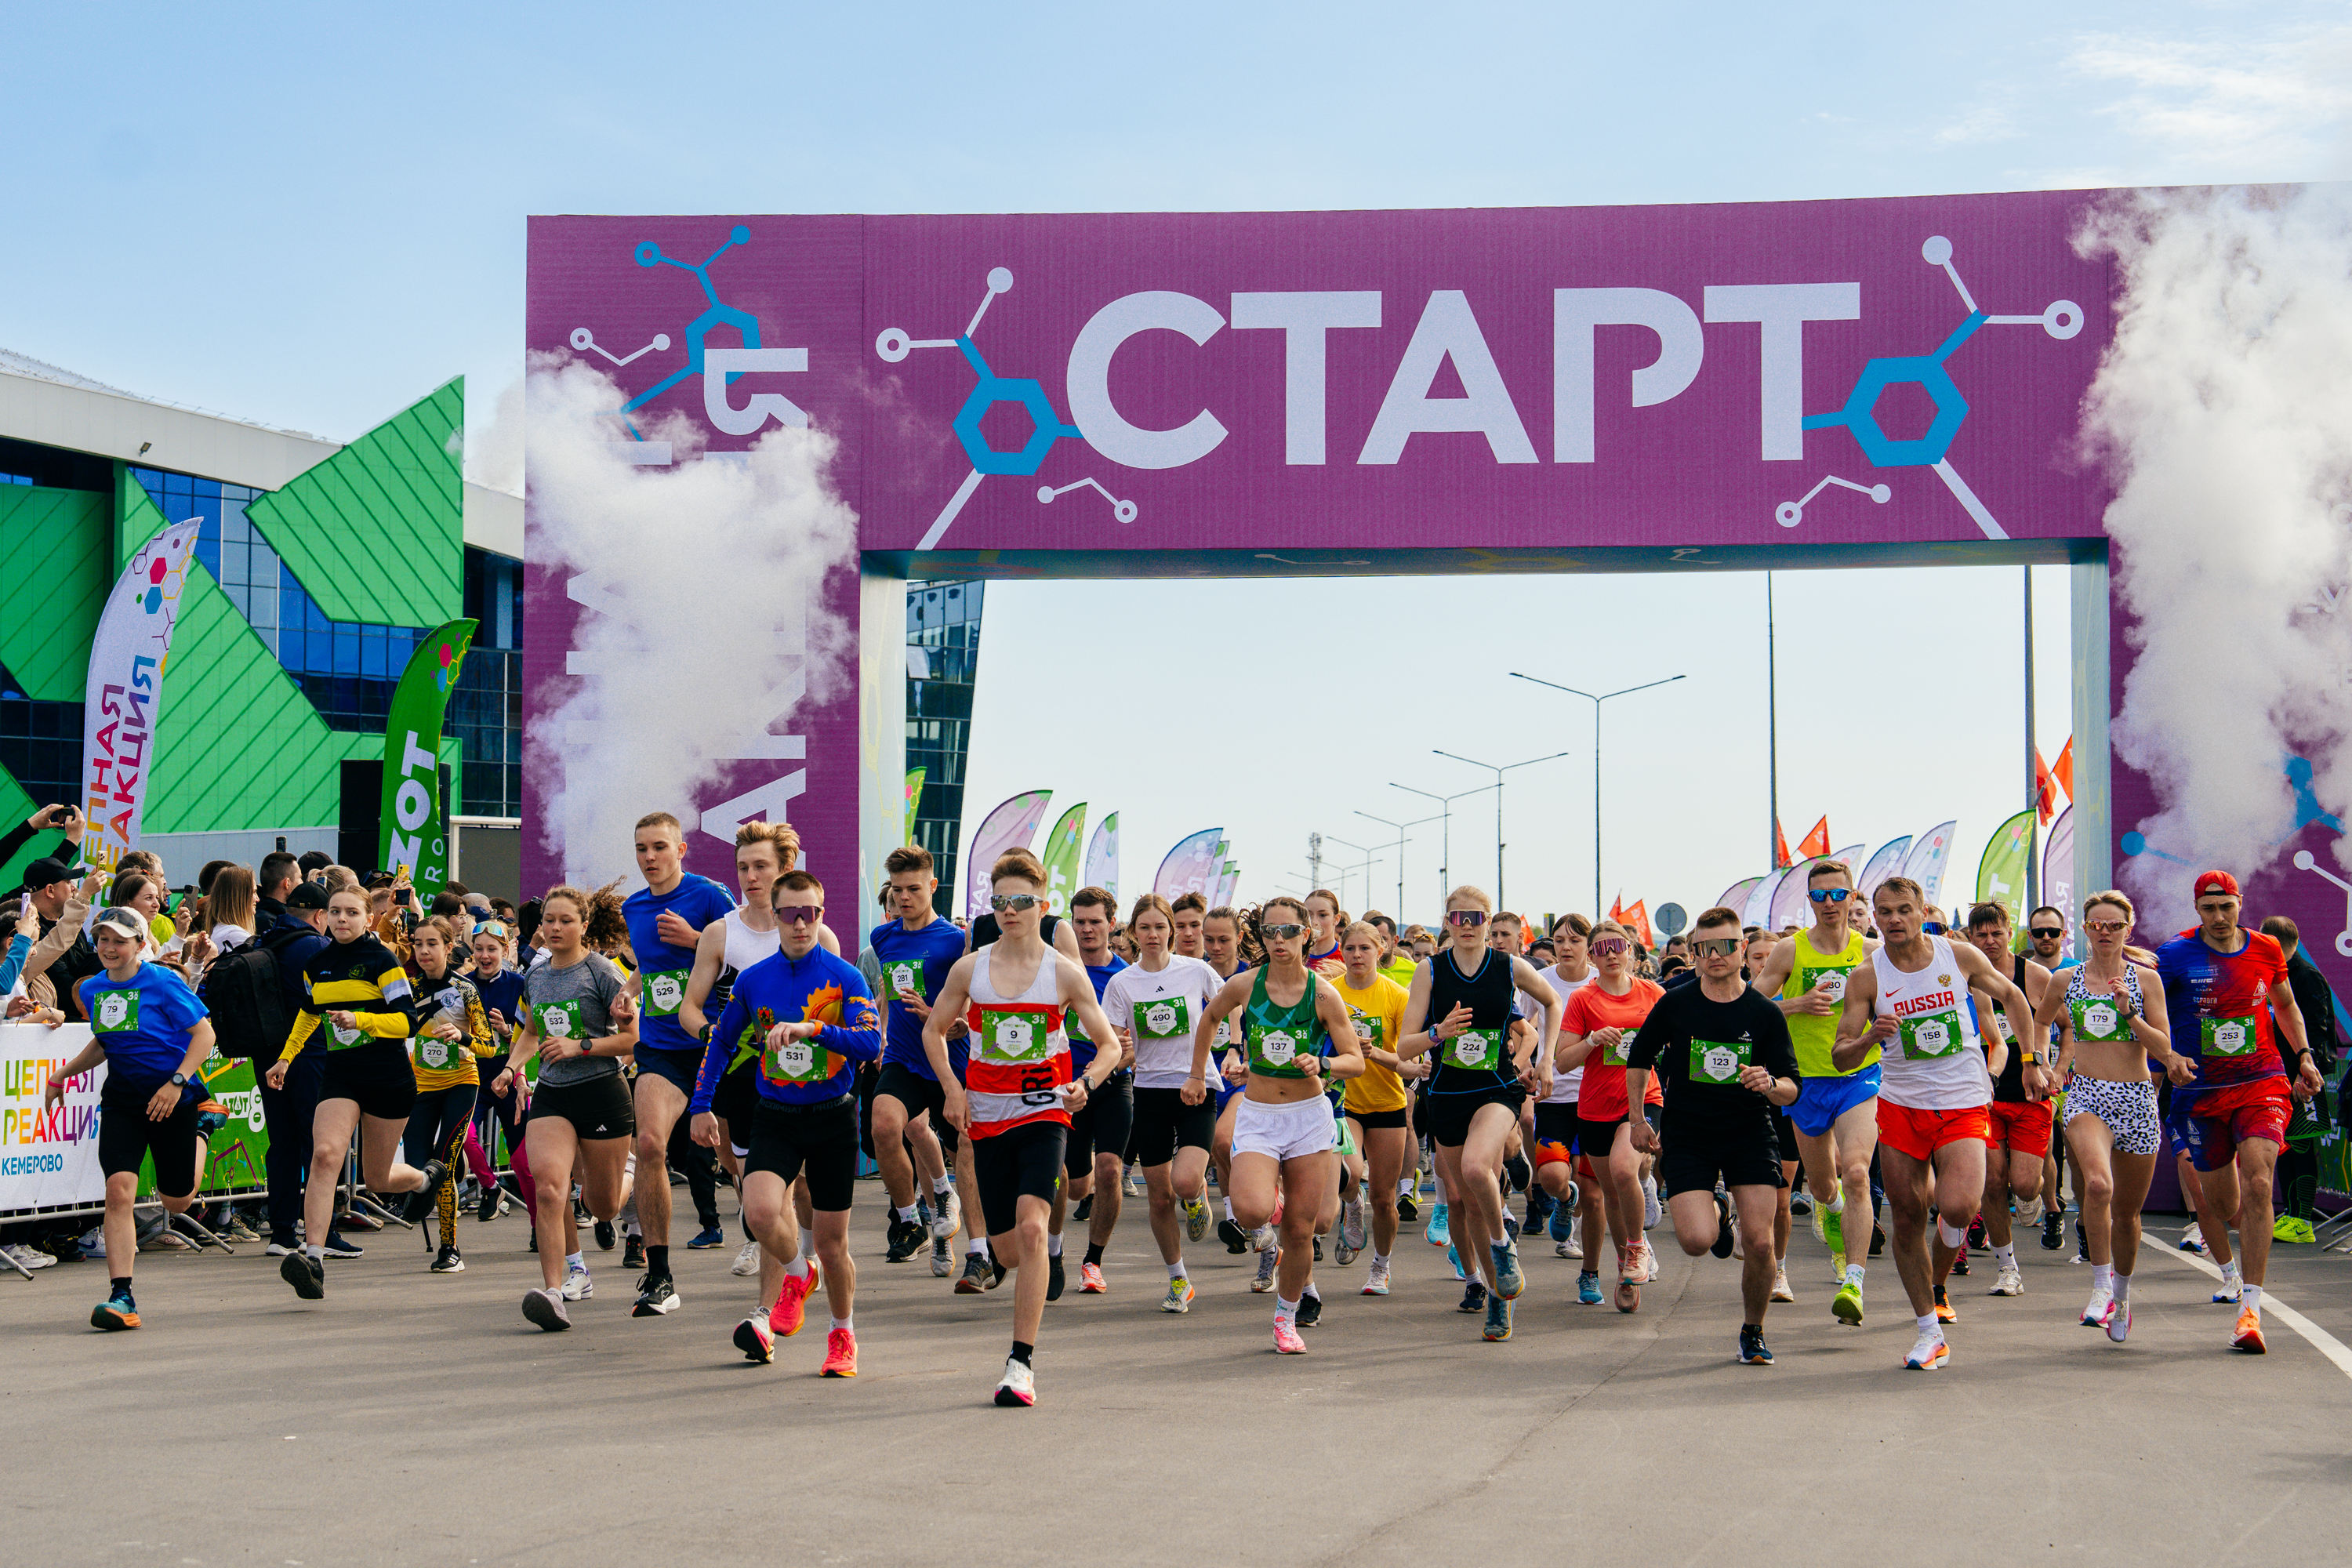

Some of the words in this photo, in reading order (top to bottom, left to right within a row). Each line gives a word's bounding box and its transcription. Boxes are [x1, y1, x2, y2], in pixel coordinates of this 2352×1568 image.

[1066, 281, 1861, 469] СТАРТ
[79, 683, 125, 906] ЕПНАЯ
[387, 730, 436, 882] ZOT
[419, 820, 444, 910] GRO
[656, 986, 674, 996] 529
[1894, 990, 1955, 1017] RUSSIA
[549, 1017, 564, 1025] 532
[1152, 1013, 1171, 1022] 490
[2092, 1014, 2108, 1023] 179
[1010, 1030, 1018, 1040] 9
[1923, 1030, 1941, 1040] 158
[2222, 1032, 2239, 1040] 253
[1462, 1043, 1480, 1052] 224
[786, 1051, 804, 1061] 531
[1712, 1058, 1730, 1066] 123
[2, 1153, 63, 1176] КЕМЕРОВО
